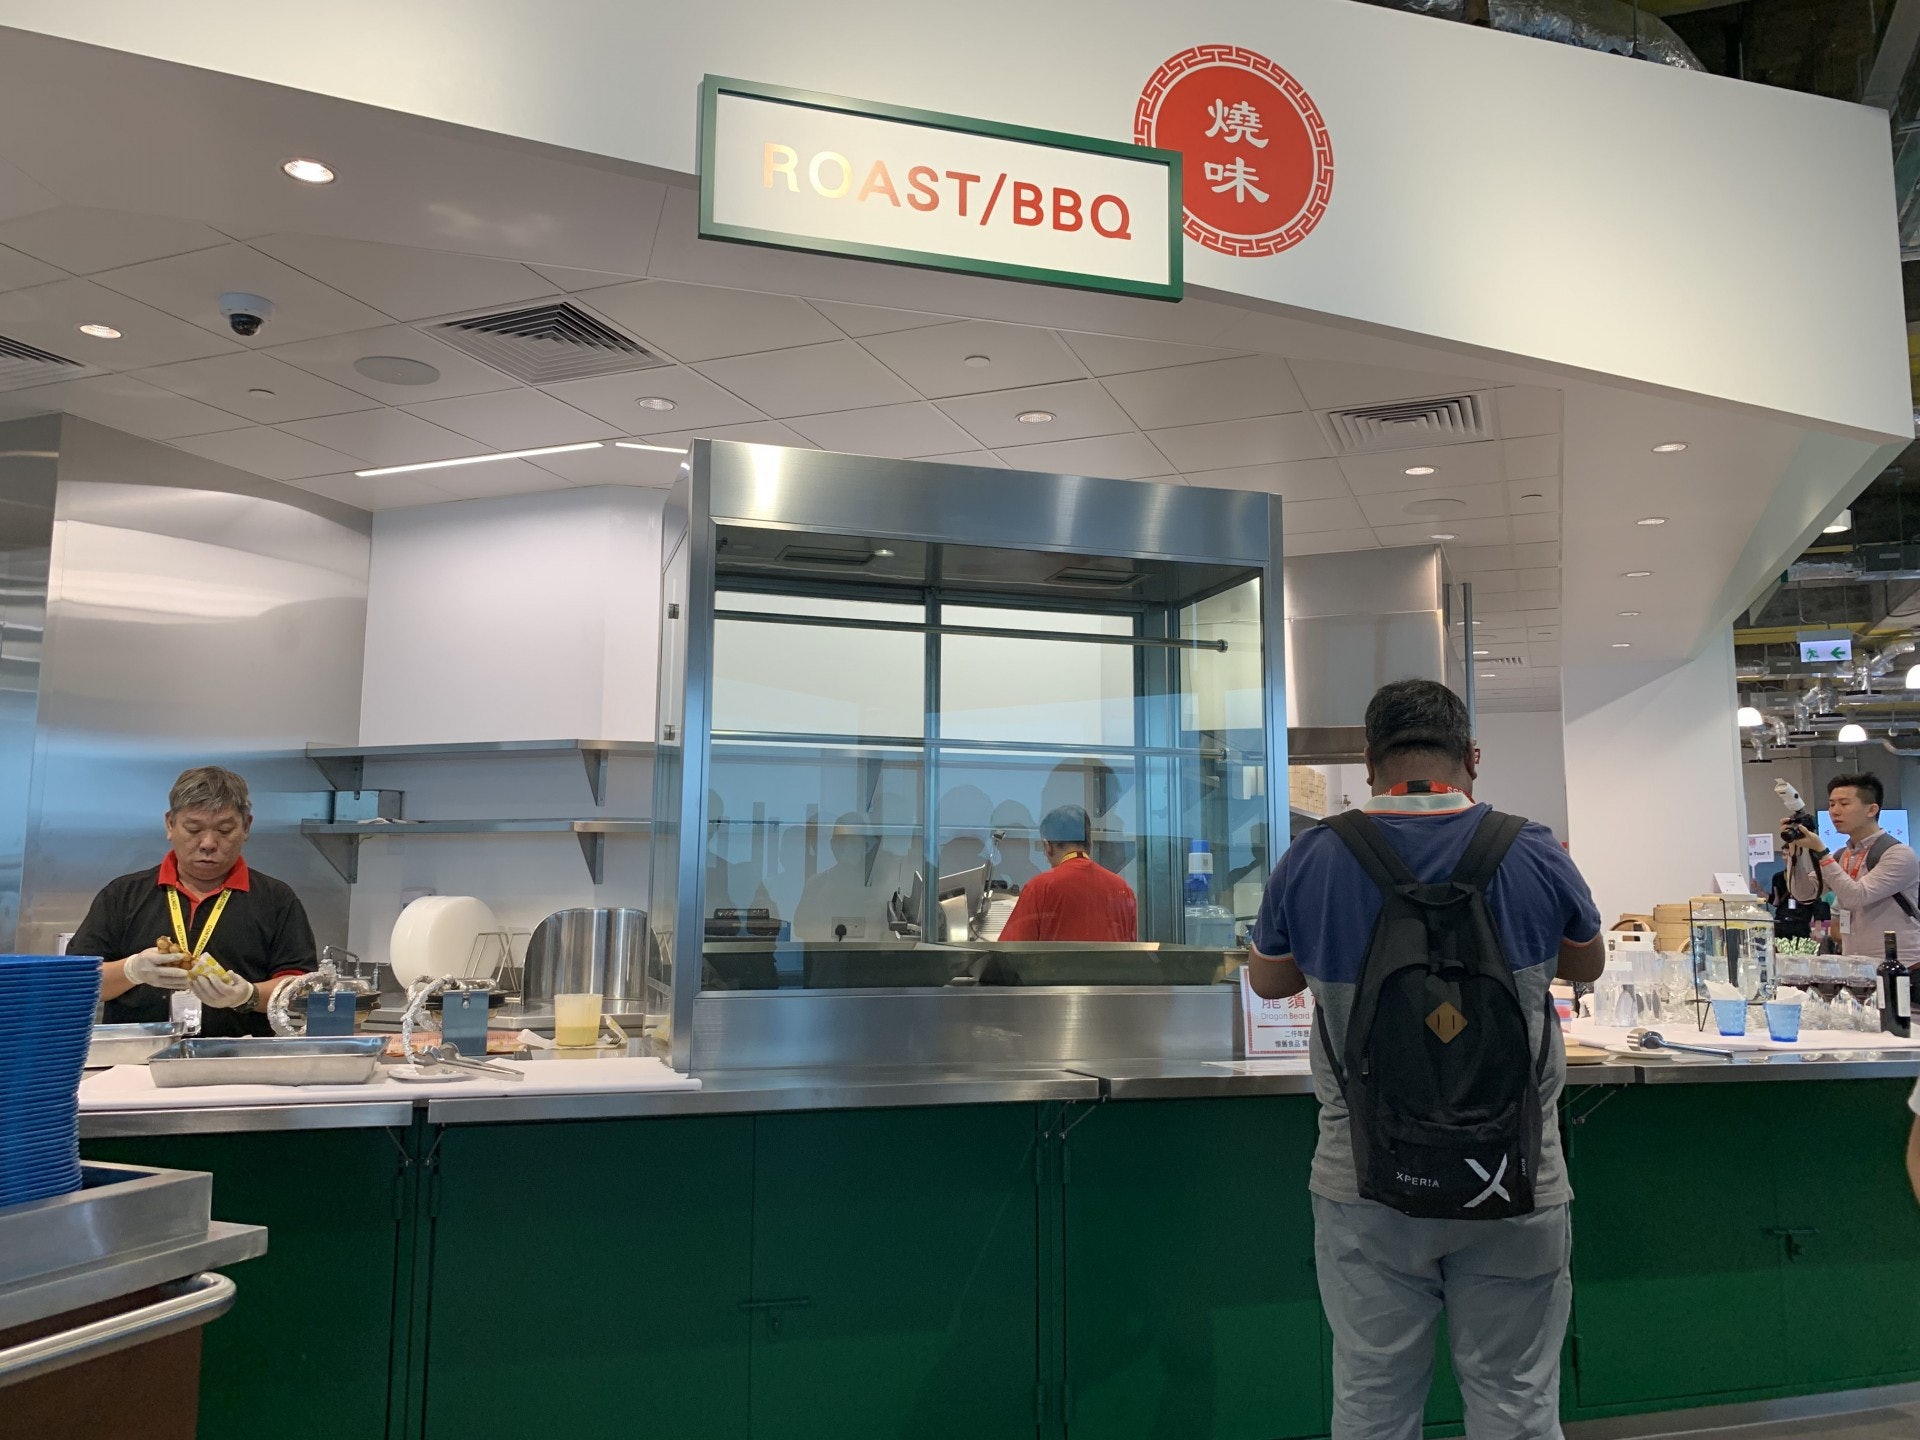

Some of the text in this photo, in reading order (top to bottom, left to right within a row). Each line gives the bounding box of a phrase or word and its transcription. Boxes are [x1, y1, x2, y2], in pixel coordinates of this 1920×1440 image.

[1204, 98, 1269, 204] 燒味
[762, 141, 1133, 241] ROAST/BBQ
[1261, 1012, 1310, 1021] Dragon Beard
[1396, 1171, 1440, 1188] XPERIA
